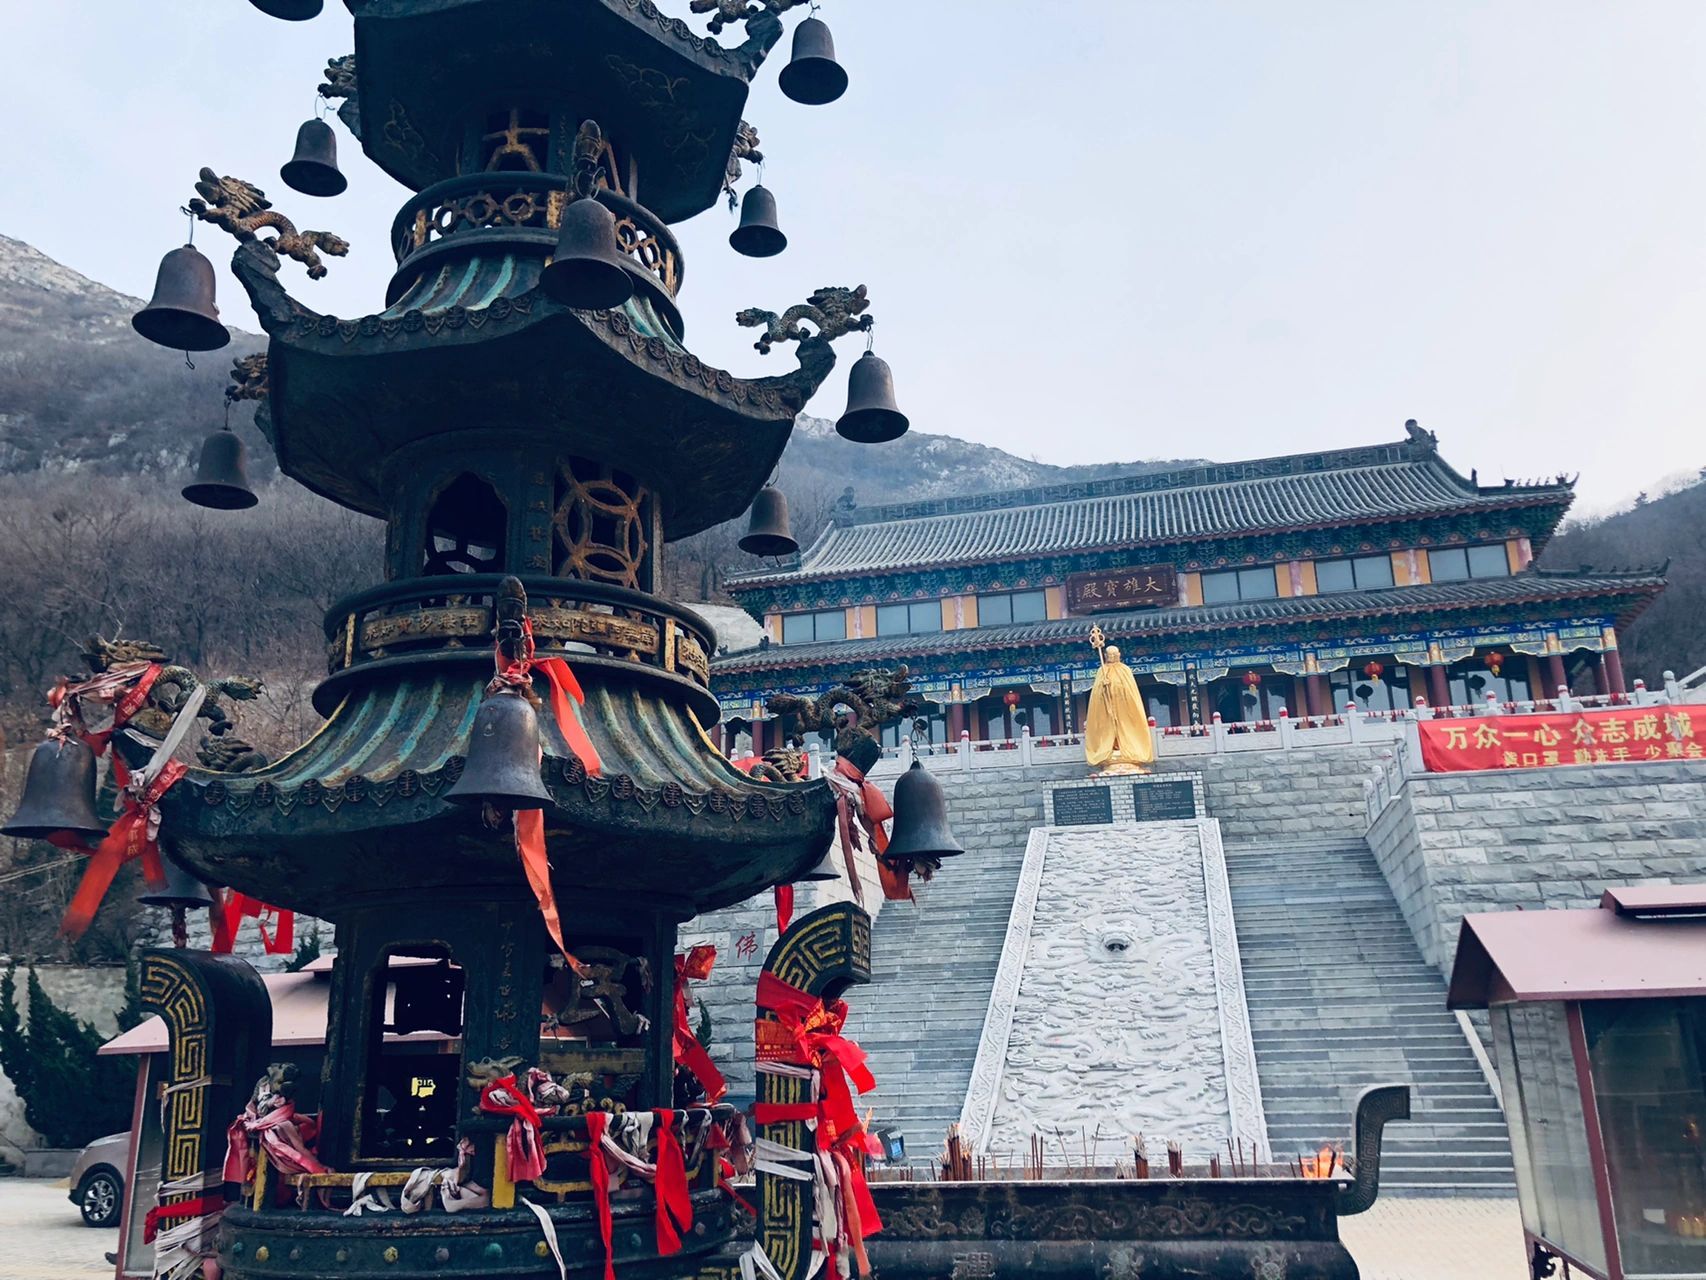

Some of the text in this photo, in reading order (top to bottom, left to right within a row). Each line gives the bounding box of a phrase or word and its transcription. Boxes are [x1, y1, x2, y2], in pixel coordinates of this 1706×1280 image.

[1440, 712, 1694, 750] 万众一心 众志成城
[1644, 741, 1703, 760] 少聚会
[735, 931, 758, 961] 佛
